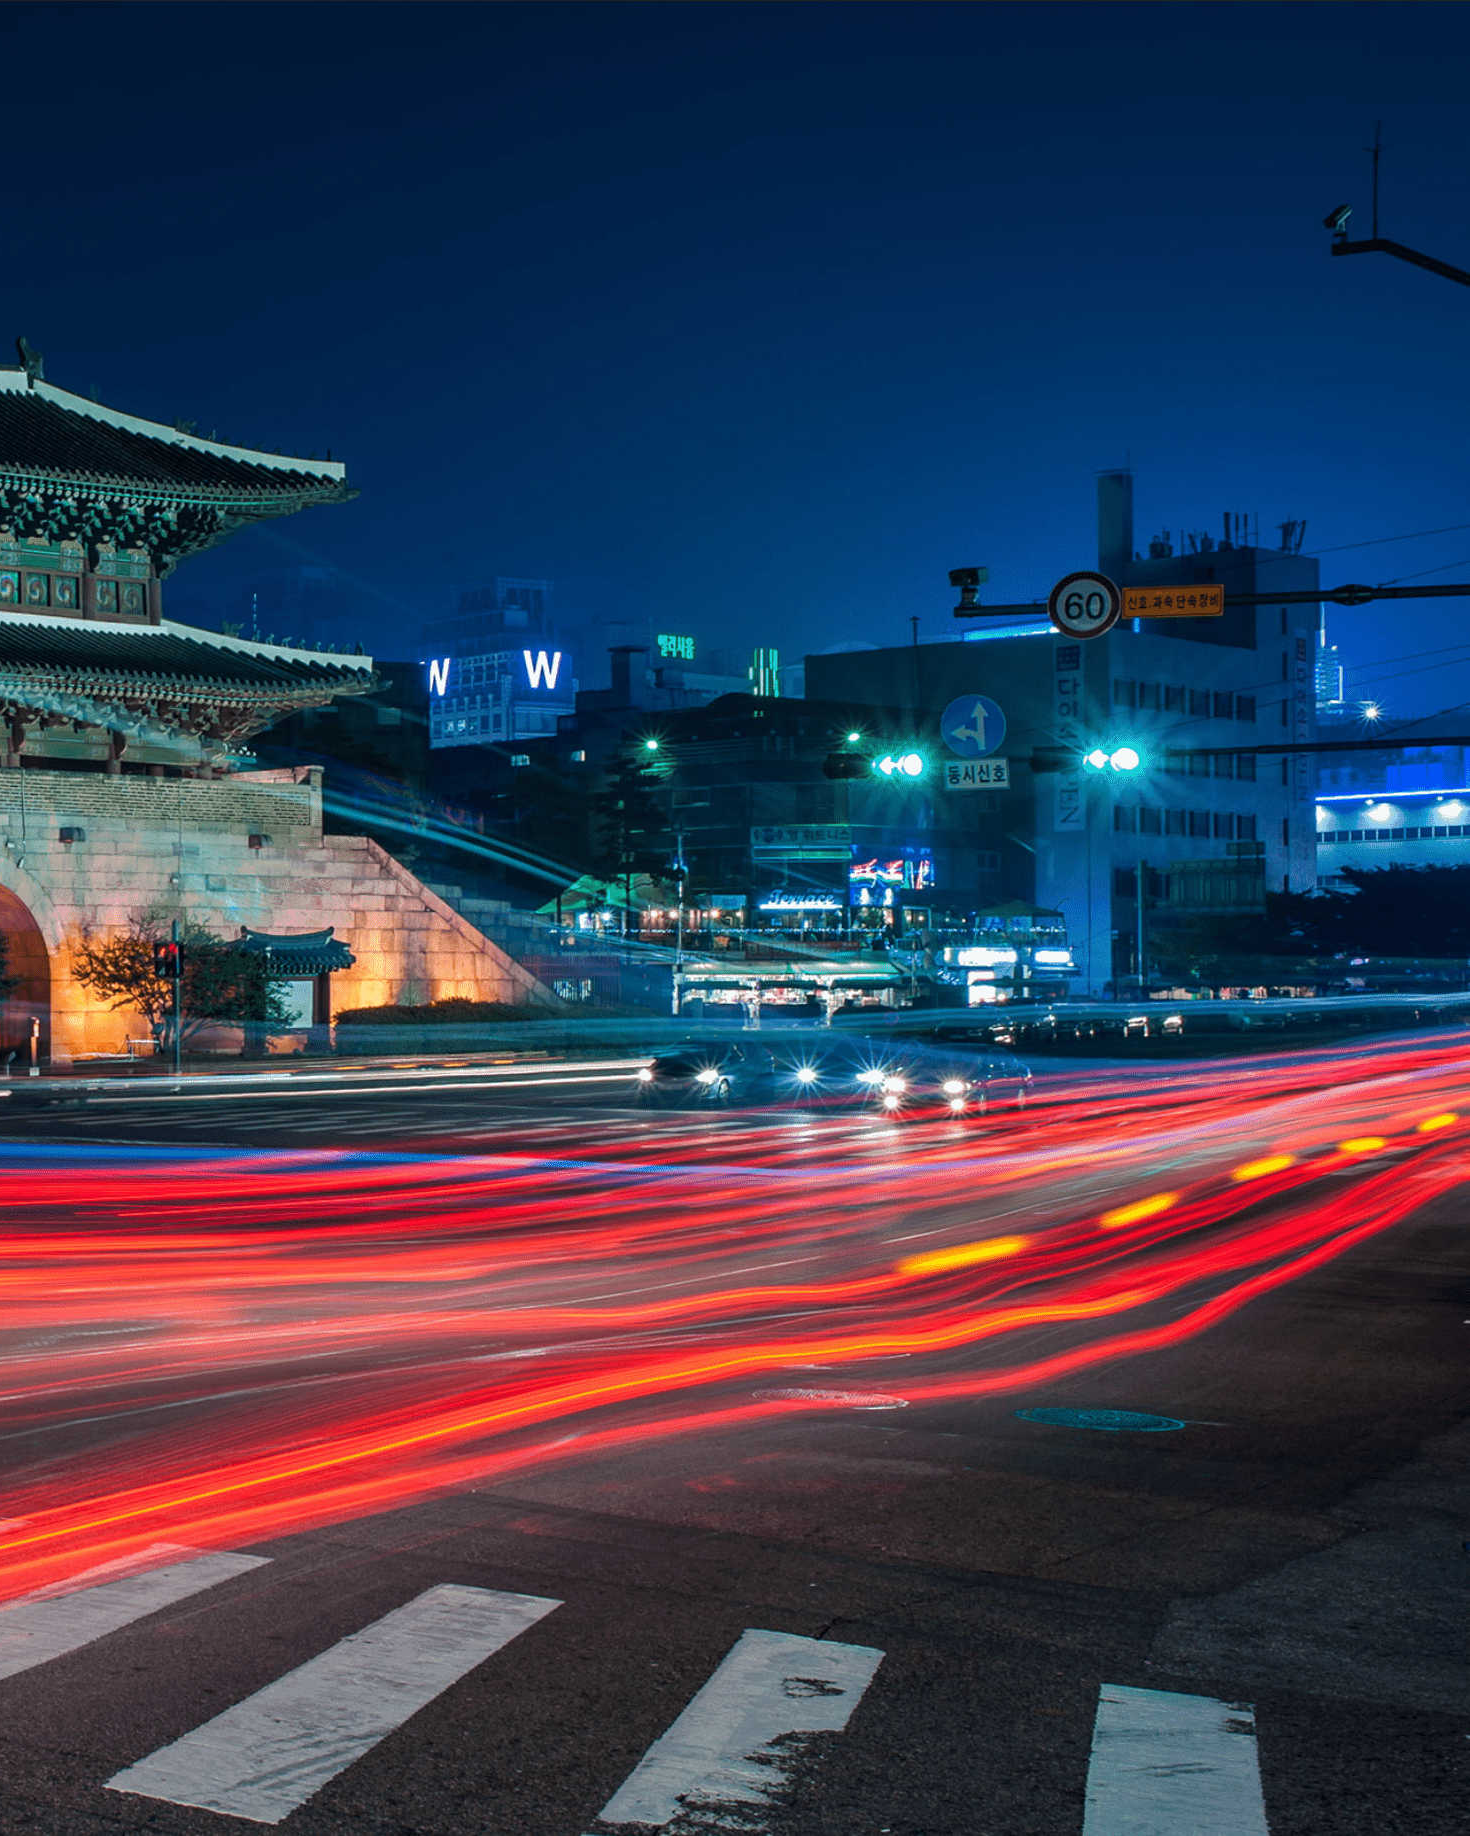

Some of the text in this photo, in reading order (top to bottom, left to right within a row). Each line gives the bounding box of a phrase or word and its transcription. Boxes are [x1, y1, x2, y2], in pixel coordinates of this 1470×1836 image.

[1064, 592, 1105, 620] 60
[523, 650, 562, 690] W
[948, 763, 1006, 785] 동시신호
